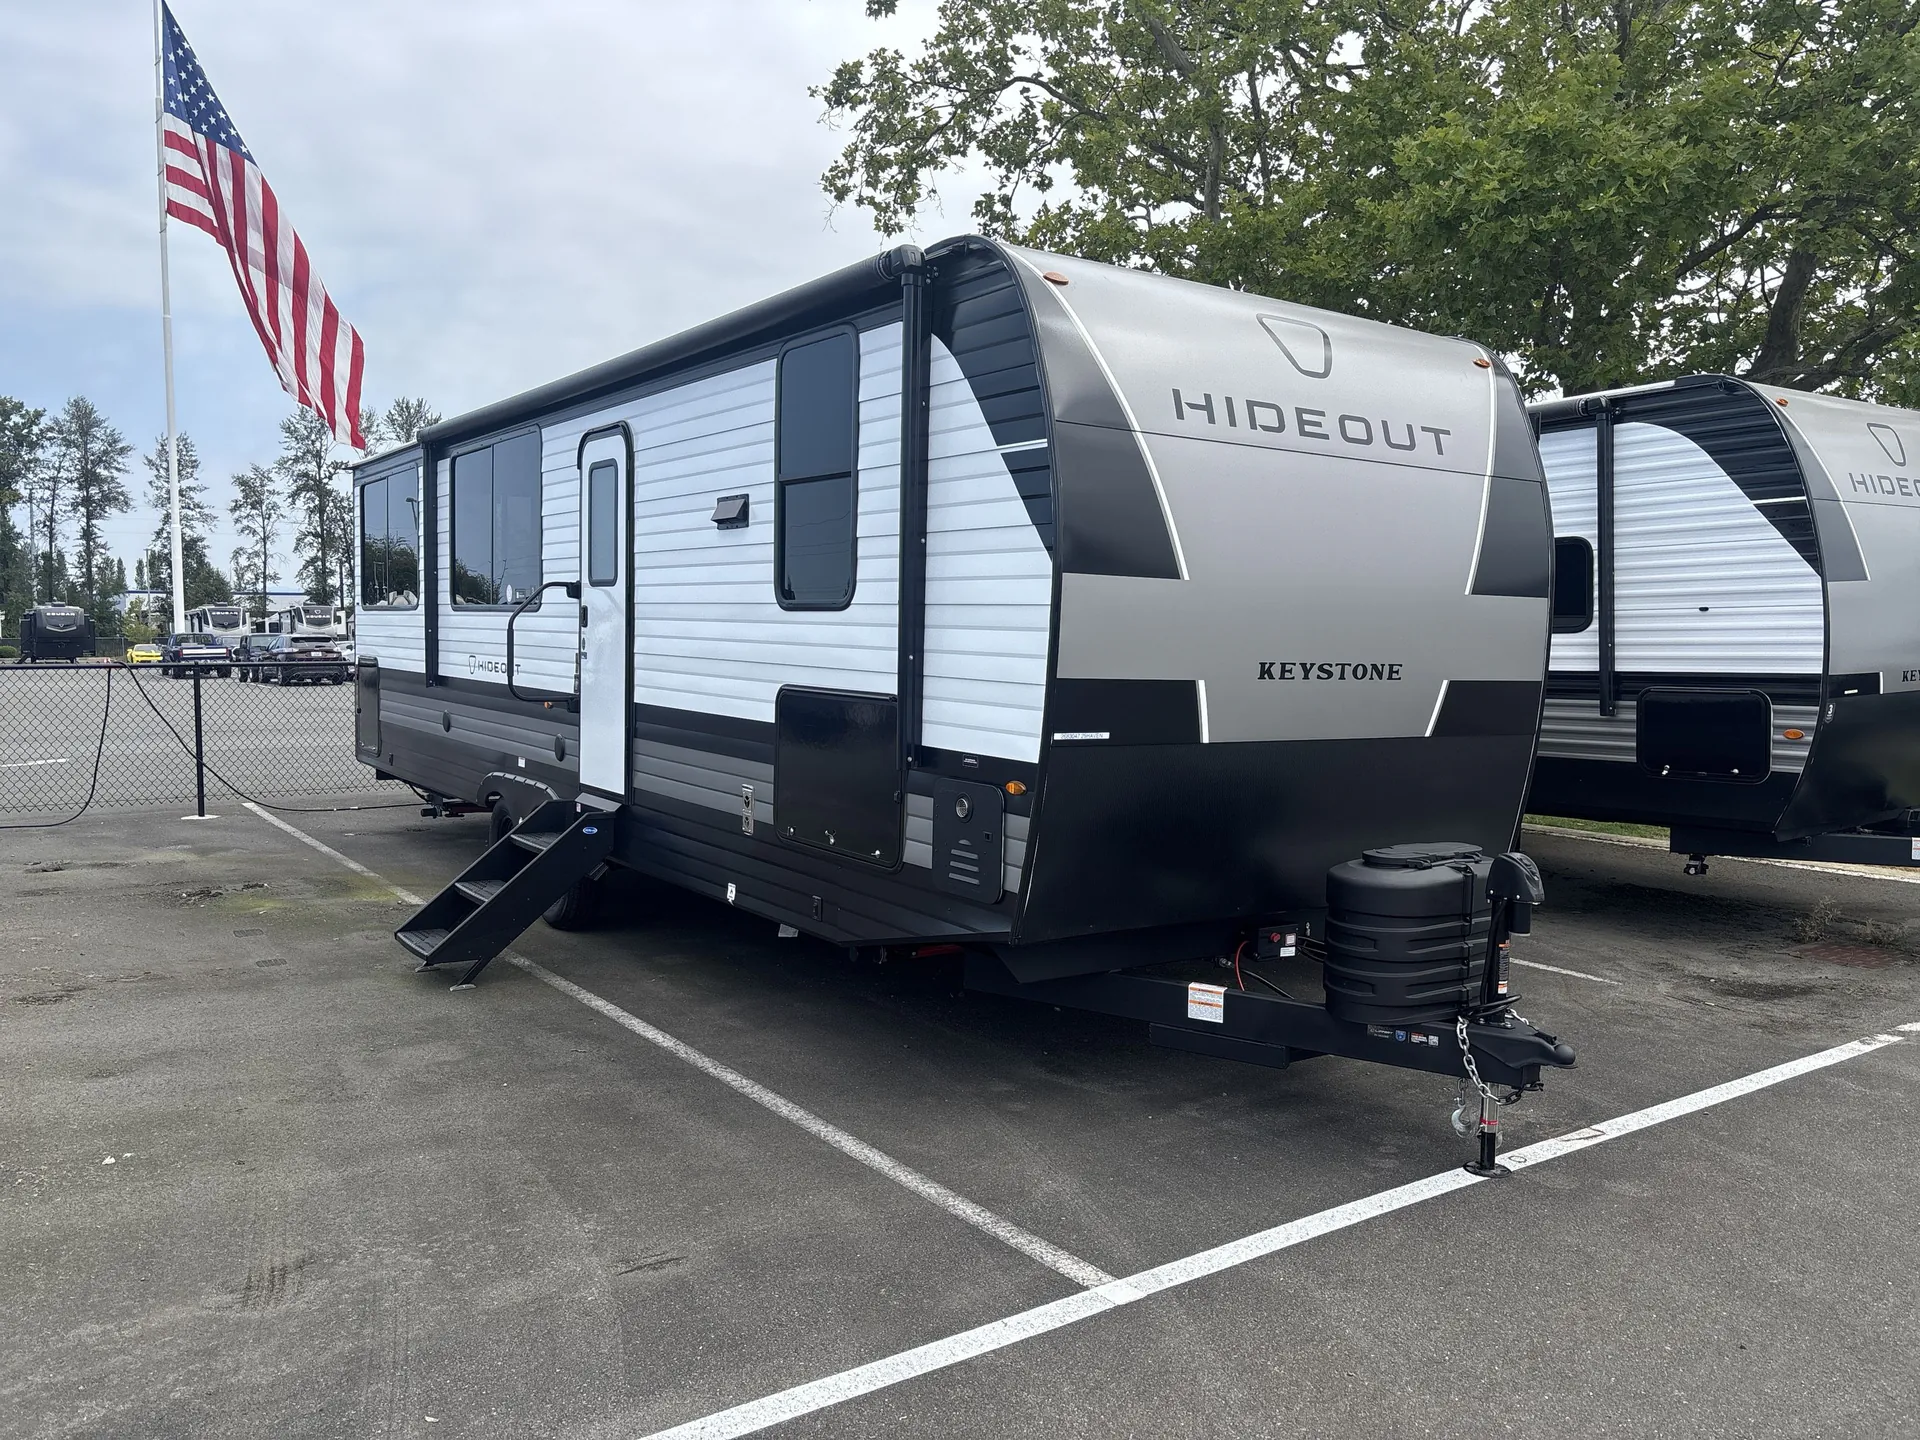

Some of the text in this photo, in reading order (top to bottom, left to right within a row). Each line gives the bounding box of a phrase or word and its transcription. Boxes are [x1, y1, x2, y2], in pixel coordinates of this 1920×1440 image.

[1172, 388, 1451, 456] HIDEOUT
[478, 660, 521, 676] HIDEOT
[1257, 662, 1403, 680] KEYSTONE
[1902, 669, 1920, 683] KE
